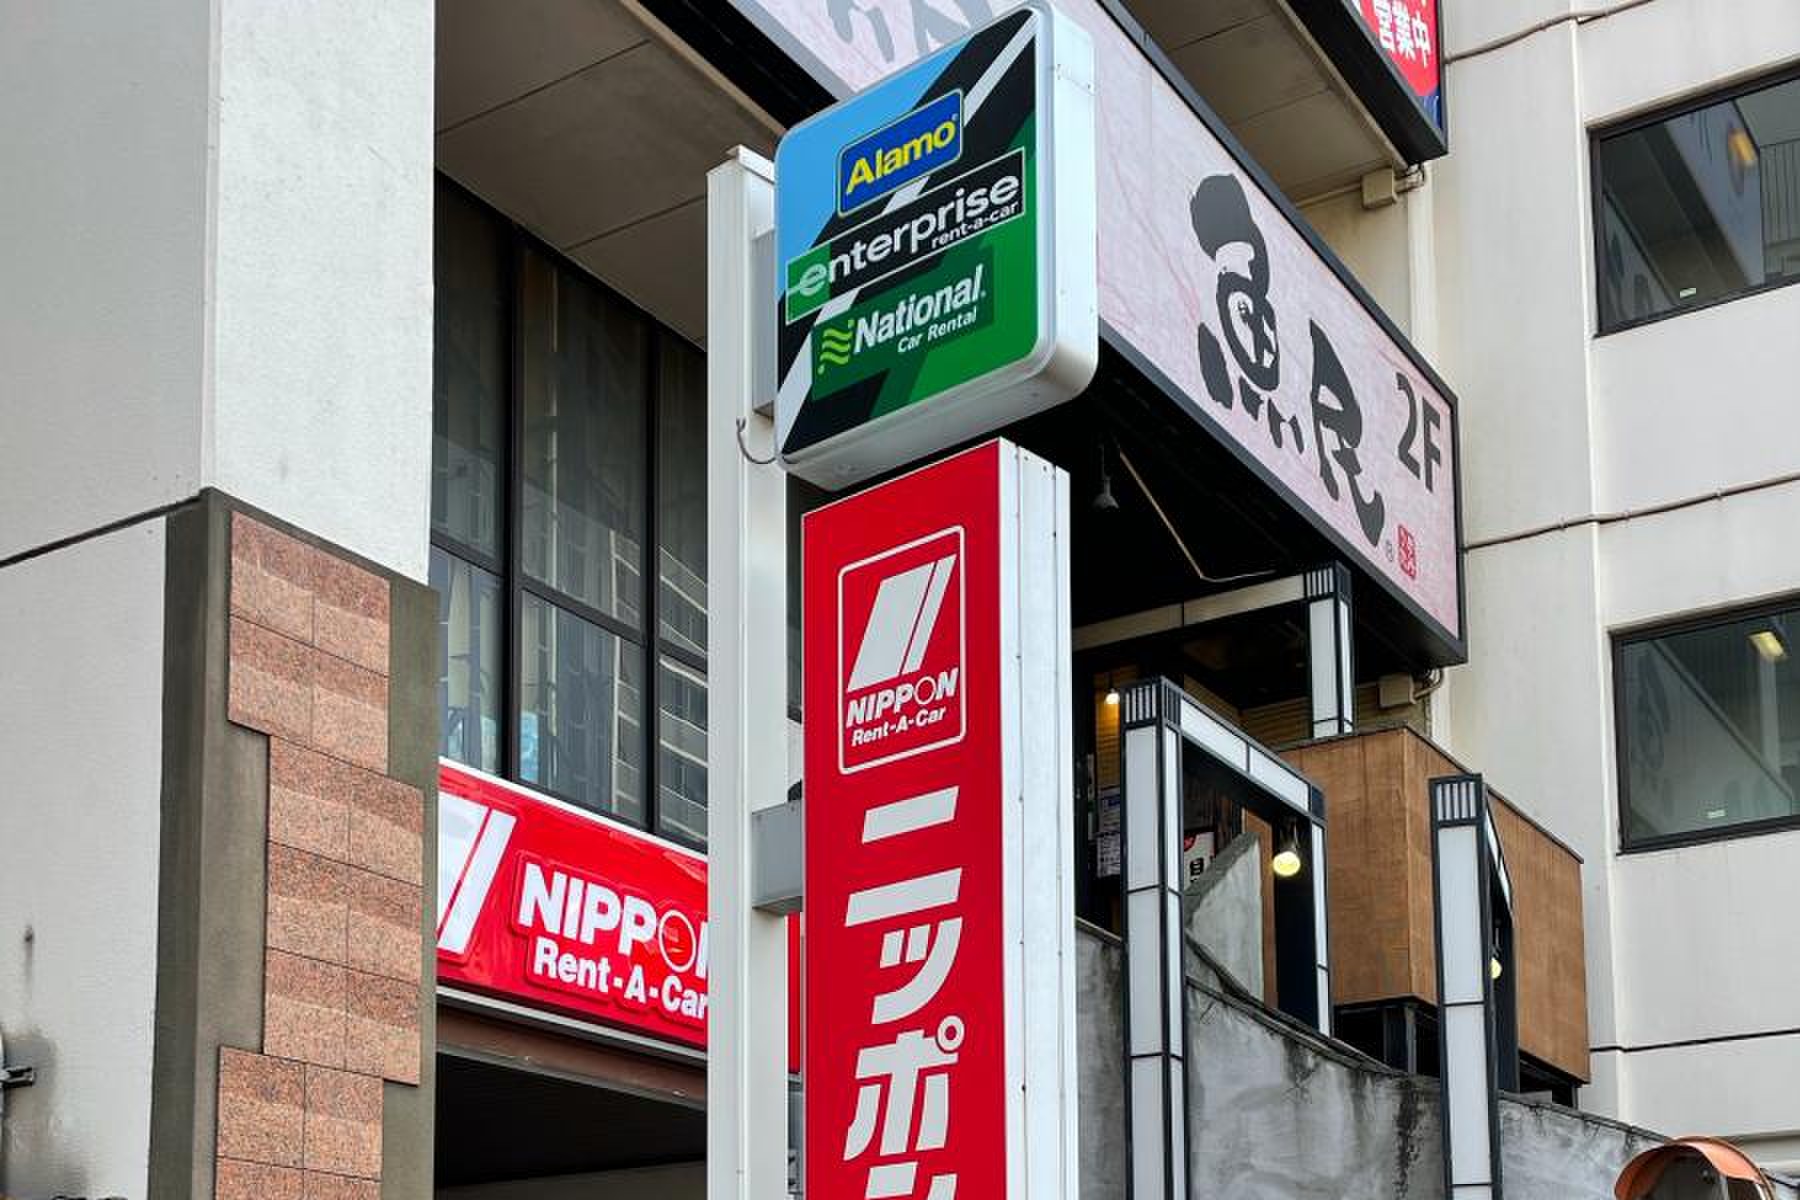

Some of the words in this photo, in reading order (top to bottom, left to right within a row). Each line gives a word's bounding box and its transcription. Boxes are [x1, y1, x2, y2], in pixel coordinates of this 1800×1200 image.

[846, 120, 957, 195] Alamo
[787, 174, 1020, 297] enterprise
[931, 201, 1019, 249] rent-a-car
[853, 263, 984, 355] National
[897, 331, 923, 353] Car
[927, 308, 978, 341] Rental
[1396, 372, 1442, 494] 2F
[845, 667, 959, 728] NIPPON
[850, 706, 947, 748] Rent-A-Car
[517, 862, 708, 979] NIPPO
